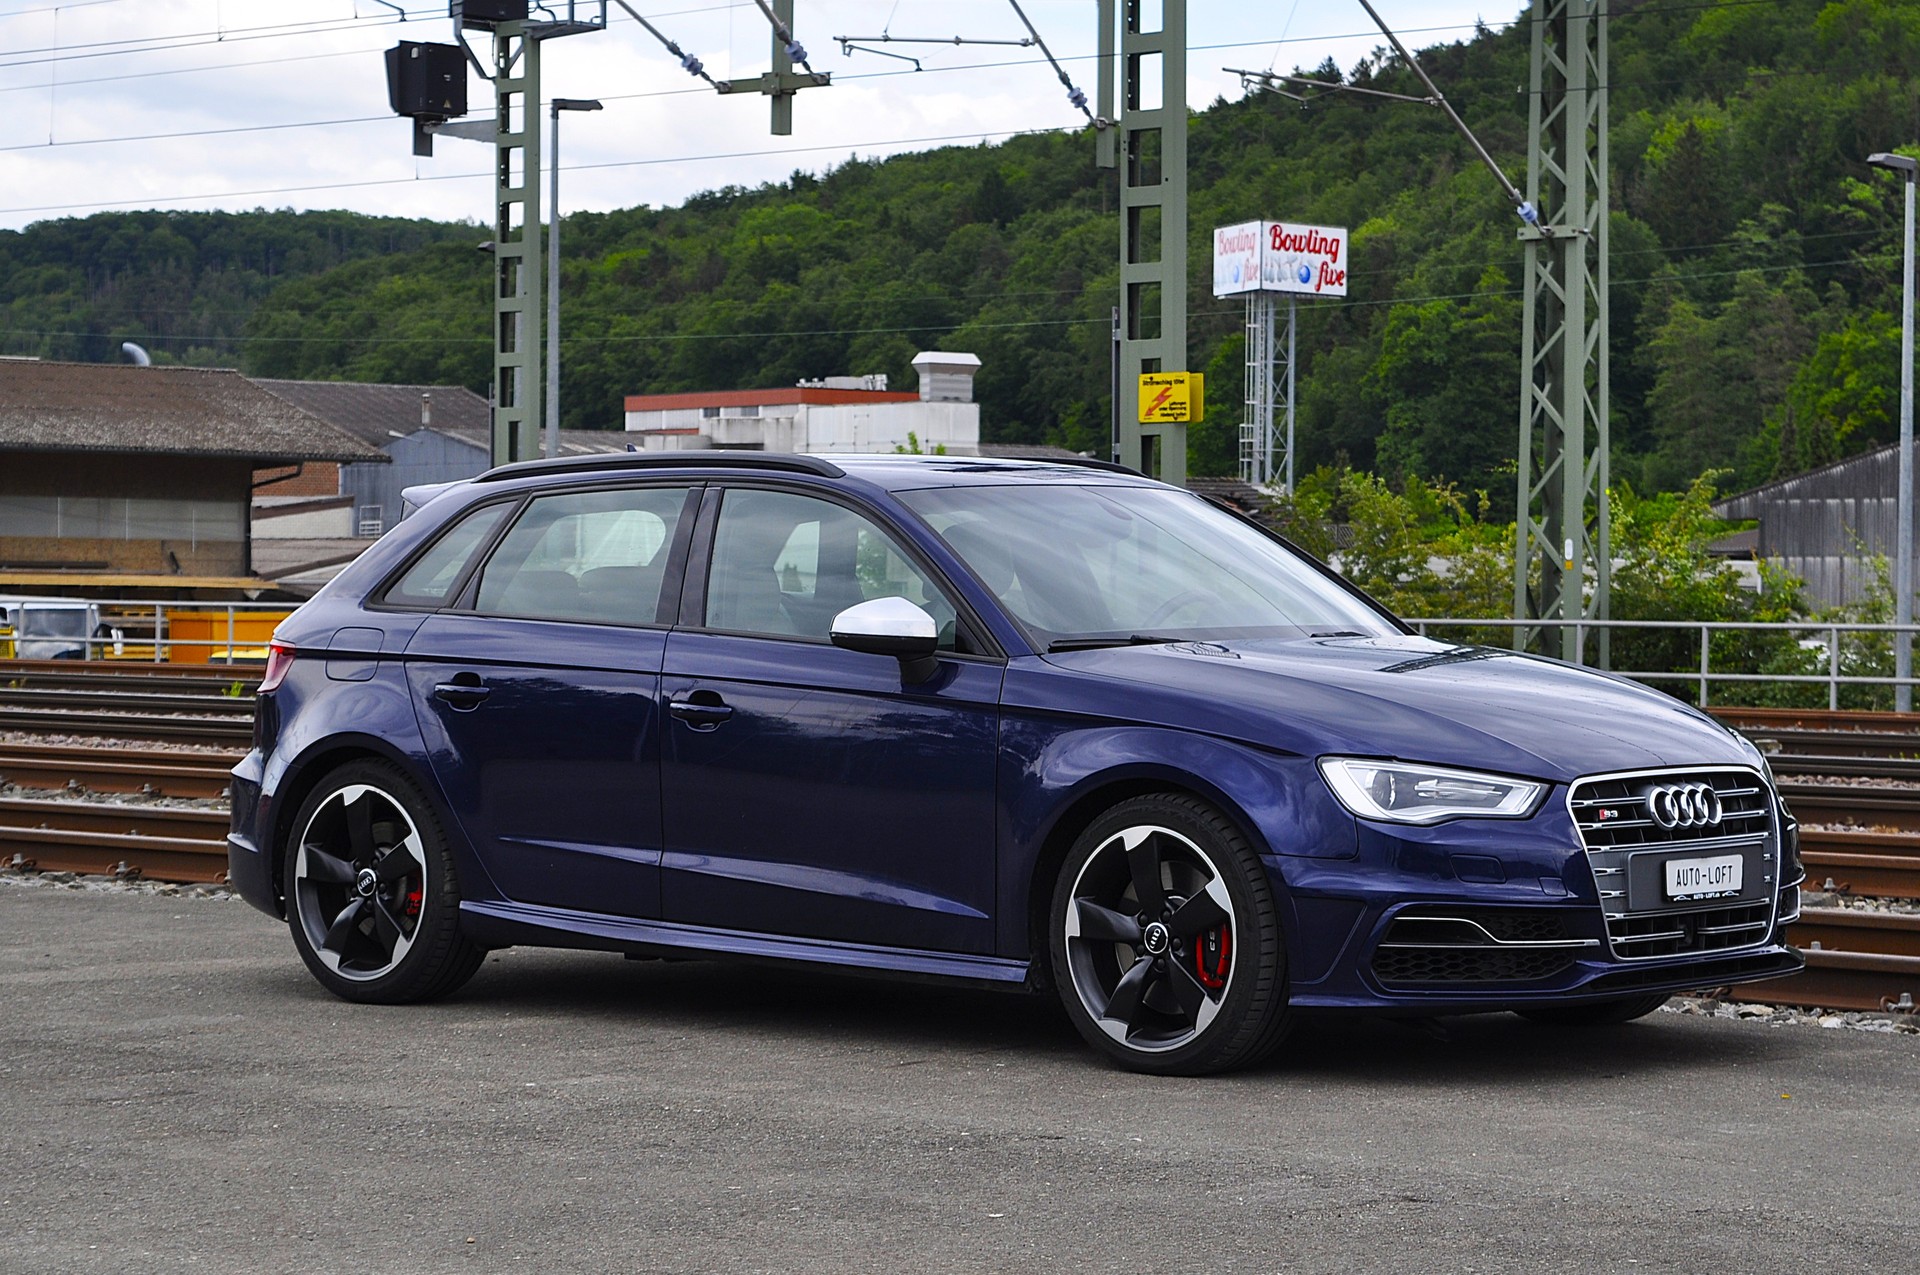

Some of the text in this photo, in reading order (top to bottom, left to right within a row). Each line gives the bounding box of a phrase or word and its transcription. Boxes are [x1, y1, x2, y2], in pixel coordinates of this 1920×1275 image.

[1219, 228, 1256, 258] Bowling
[1270, 224, 1340, 263] Bowling
[1242, 258, 1258, 289] five
[1315, 261, 1345, 292] five
[1602, 809, 1618, 818] S3
[1676, 865, 1733, 887] AUTO-LOFT
